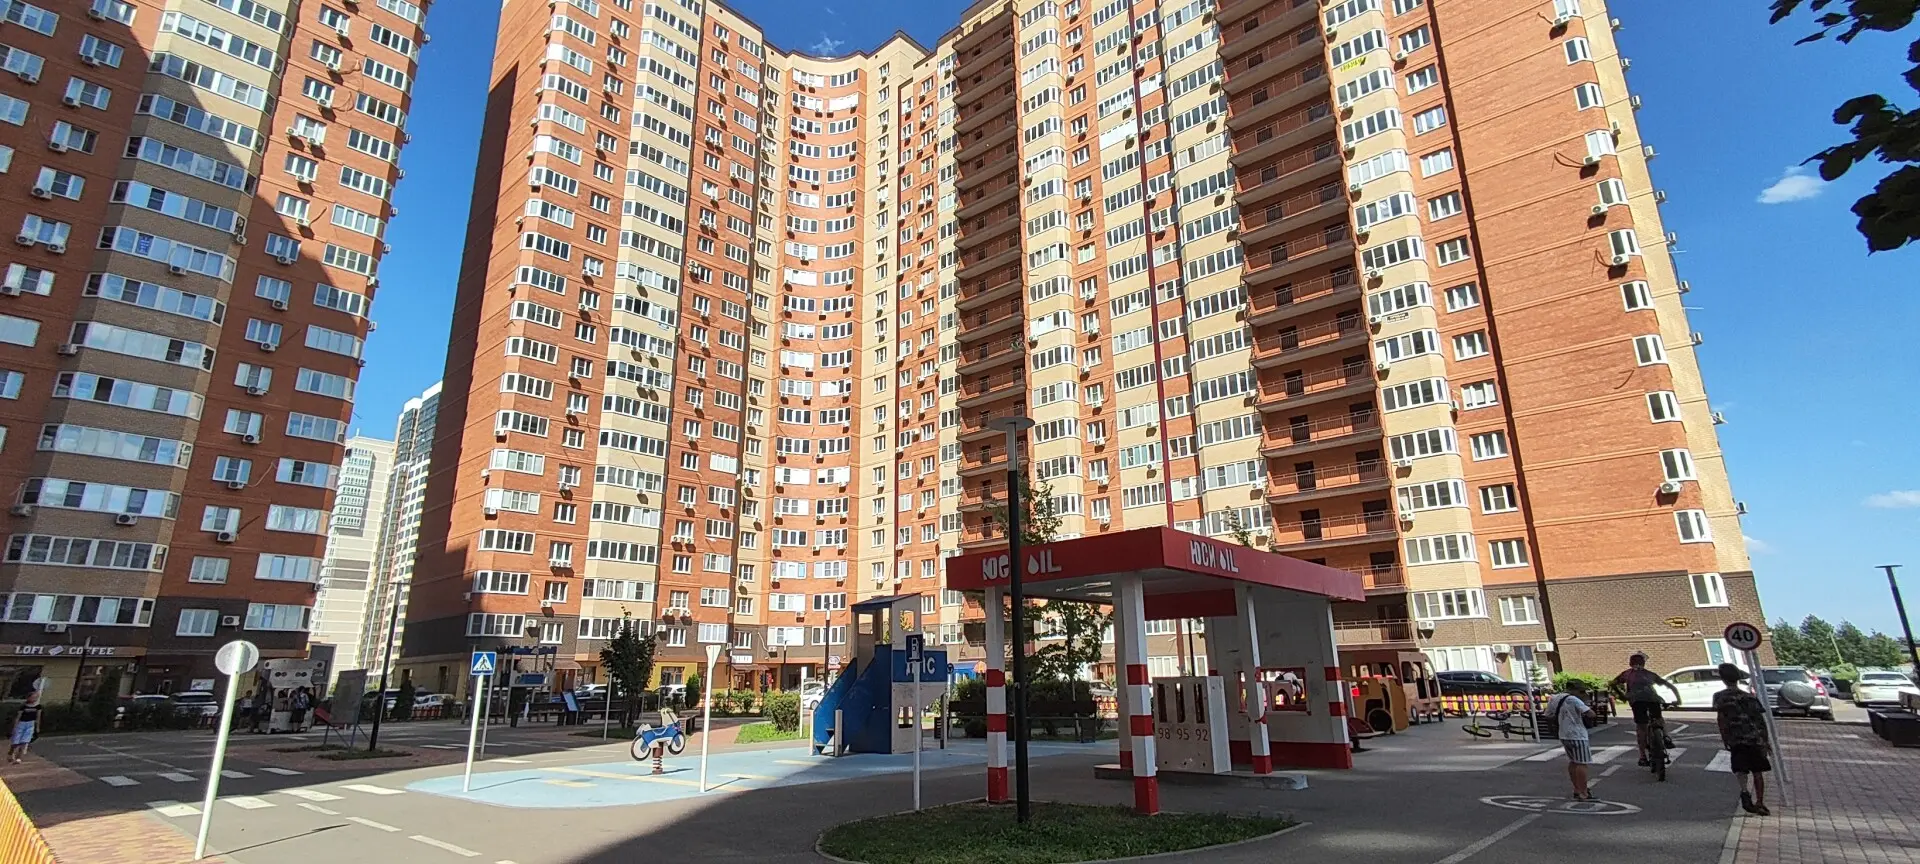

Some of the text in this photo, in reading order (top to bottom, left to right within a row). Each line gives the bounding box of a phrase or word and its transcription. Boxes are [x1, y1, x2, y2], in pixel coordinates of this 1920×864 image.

[983, 554, 1010, 580] ЮС
[1731, 628, 1754, 642] 40
[15, 645, 44, 655] LOFI
[1158, 727, 1208, 741] 98 95 92
